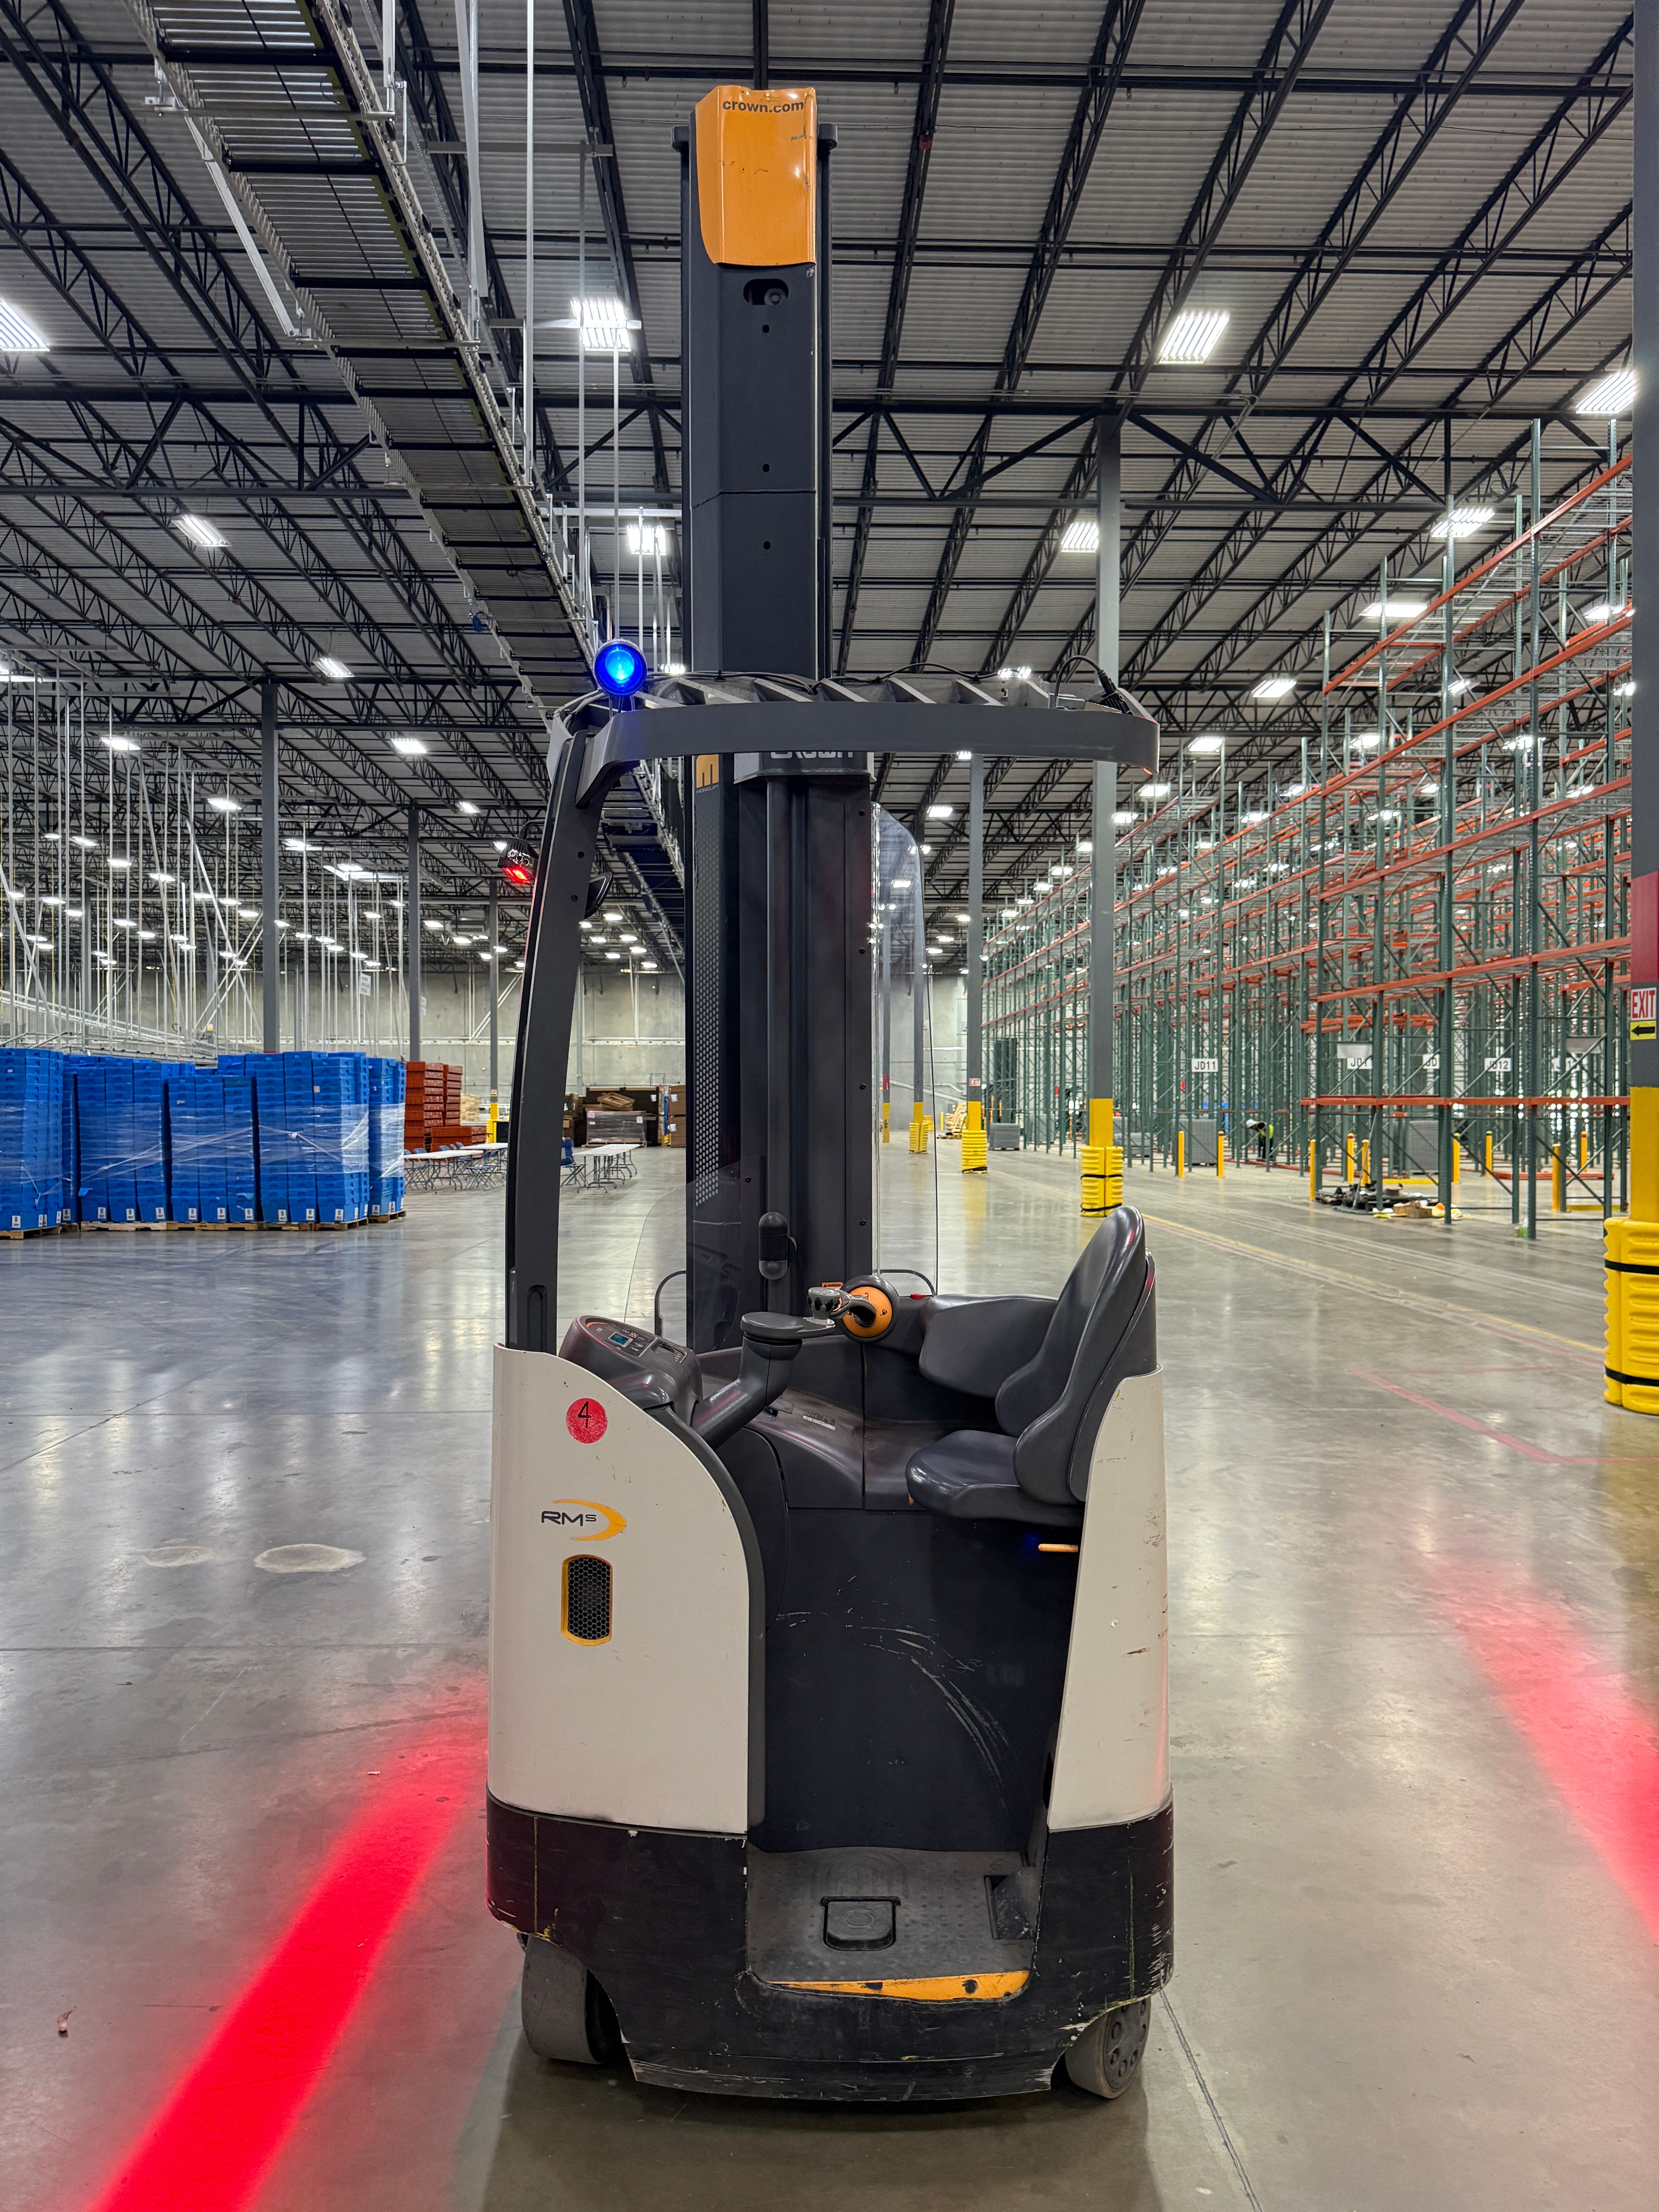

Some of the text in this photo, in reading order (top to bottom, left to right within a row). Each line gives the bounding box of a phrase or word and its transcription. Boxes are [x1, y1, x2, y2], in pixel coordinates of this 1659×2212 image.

[723, 101, 804, 113] crown.com
[1632, 990, 1656, 1018] EXIT
[1195, 1061, 1215, 1070] JD11
[578, 1401, 592, 1429] 4
